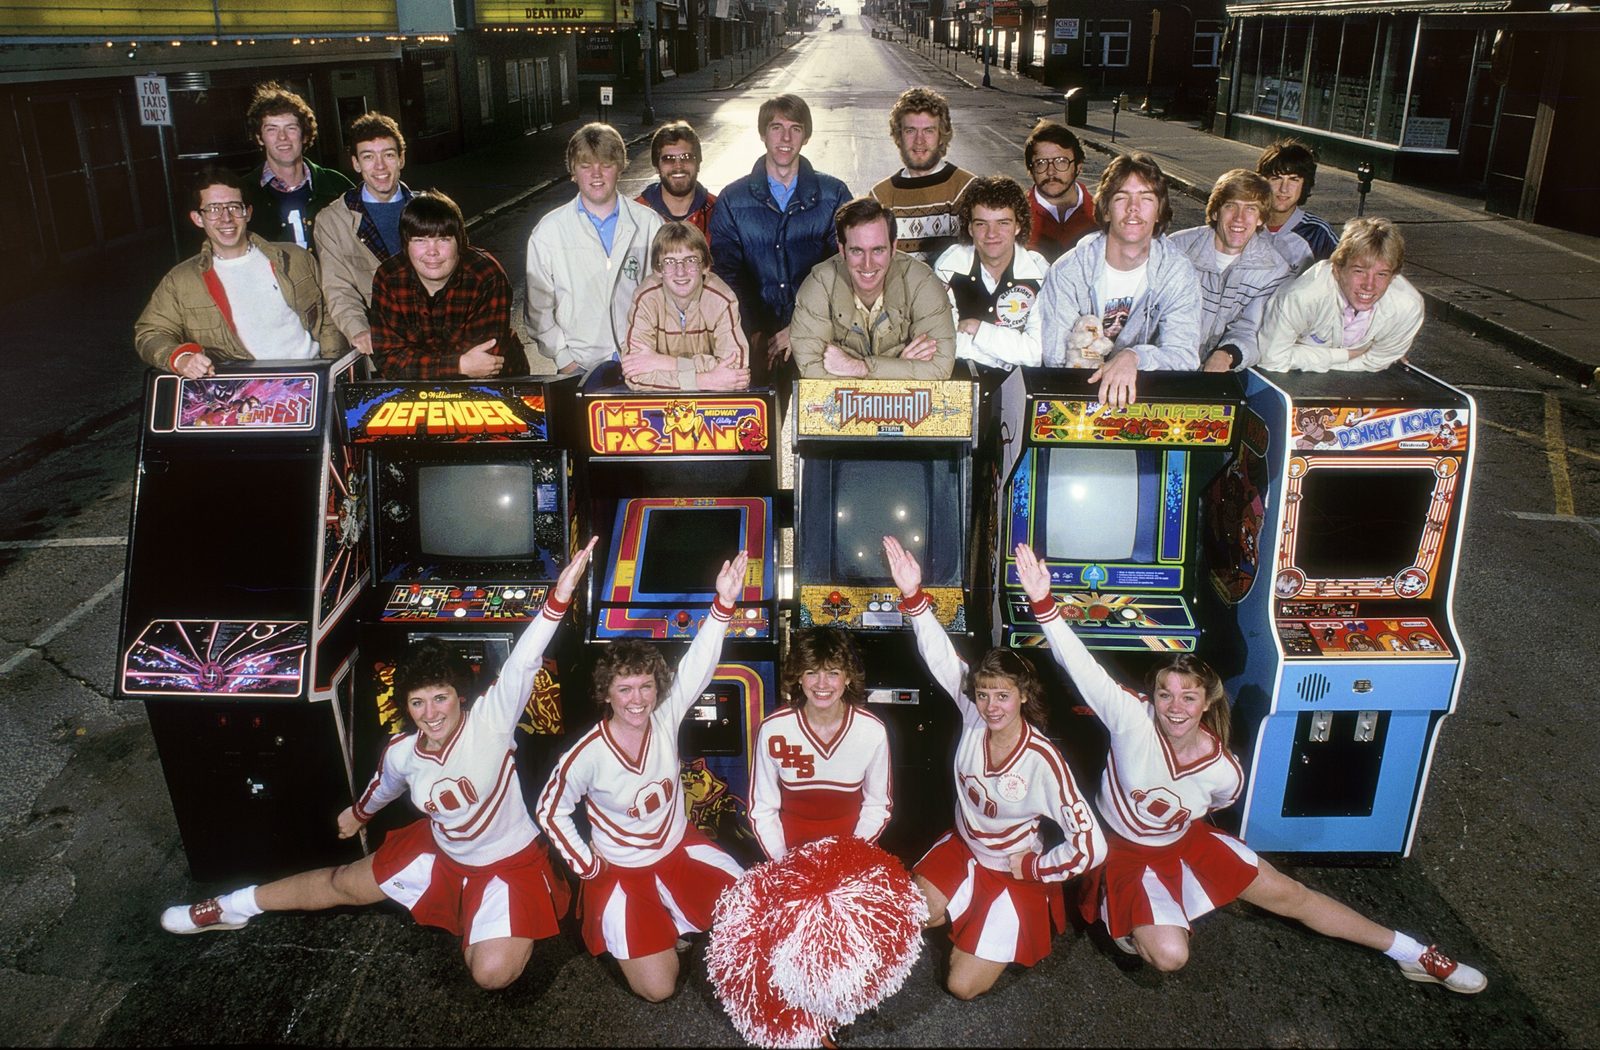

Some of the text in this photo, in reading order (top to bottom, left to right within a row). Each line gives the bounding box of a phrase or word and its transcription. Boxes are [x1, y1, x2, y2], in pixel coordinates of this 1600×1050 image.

[525, 8, 584, 19] DEATHTRAP
[141, 96, 167, 108] TAXIS
[143, 81, 160, 95] FOR
[144, 109, 167, 121] ONLY
[288, 209, 308, 250] 1
[1001, 314, 1011, 323] FUN
[237, 394, 311, 424] TEMPEST
[428, 391, 462, 399] Williams
[836, 388, 932, 427] TUTANKHAM
[366, 401, 528, 435] DEFENDER
[704, 409, 739, 417] MIDWAY
[603, 422, 741, 452] PAC-MAN
[1336, 408, 1444, 450] DONKEY KONG
[768, 735, 815, 778] OHS
[1061, 800, 1094, 834] 83
